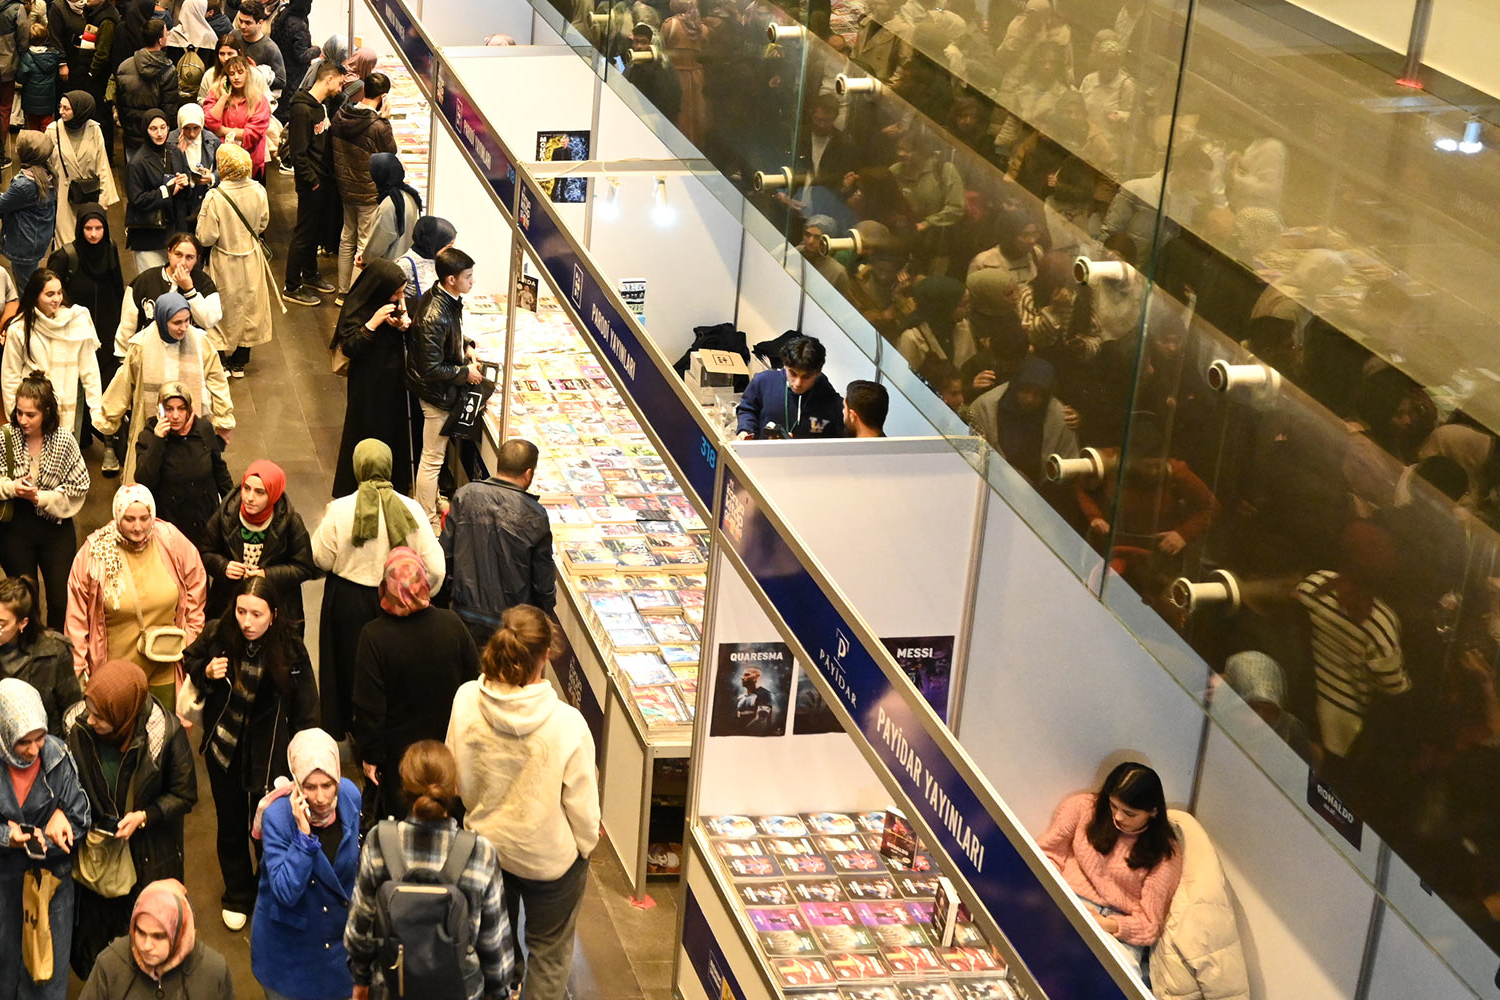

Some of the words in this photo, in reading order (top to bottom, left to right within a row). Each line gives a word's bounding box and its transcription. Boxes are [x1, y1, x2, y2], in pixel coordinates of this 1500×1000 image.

[609, 327, 636, 381] YAYINLARI
[700, 436, 716, 469] 318
[730, 652, 784, 662] QUARESMA
[877, 706, 922, 788] PAYİDAR
[924, 769, 985, 873] YAYINLARI
[1316, 783, 1354, 824] RONALDO
